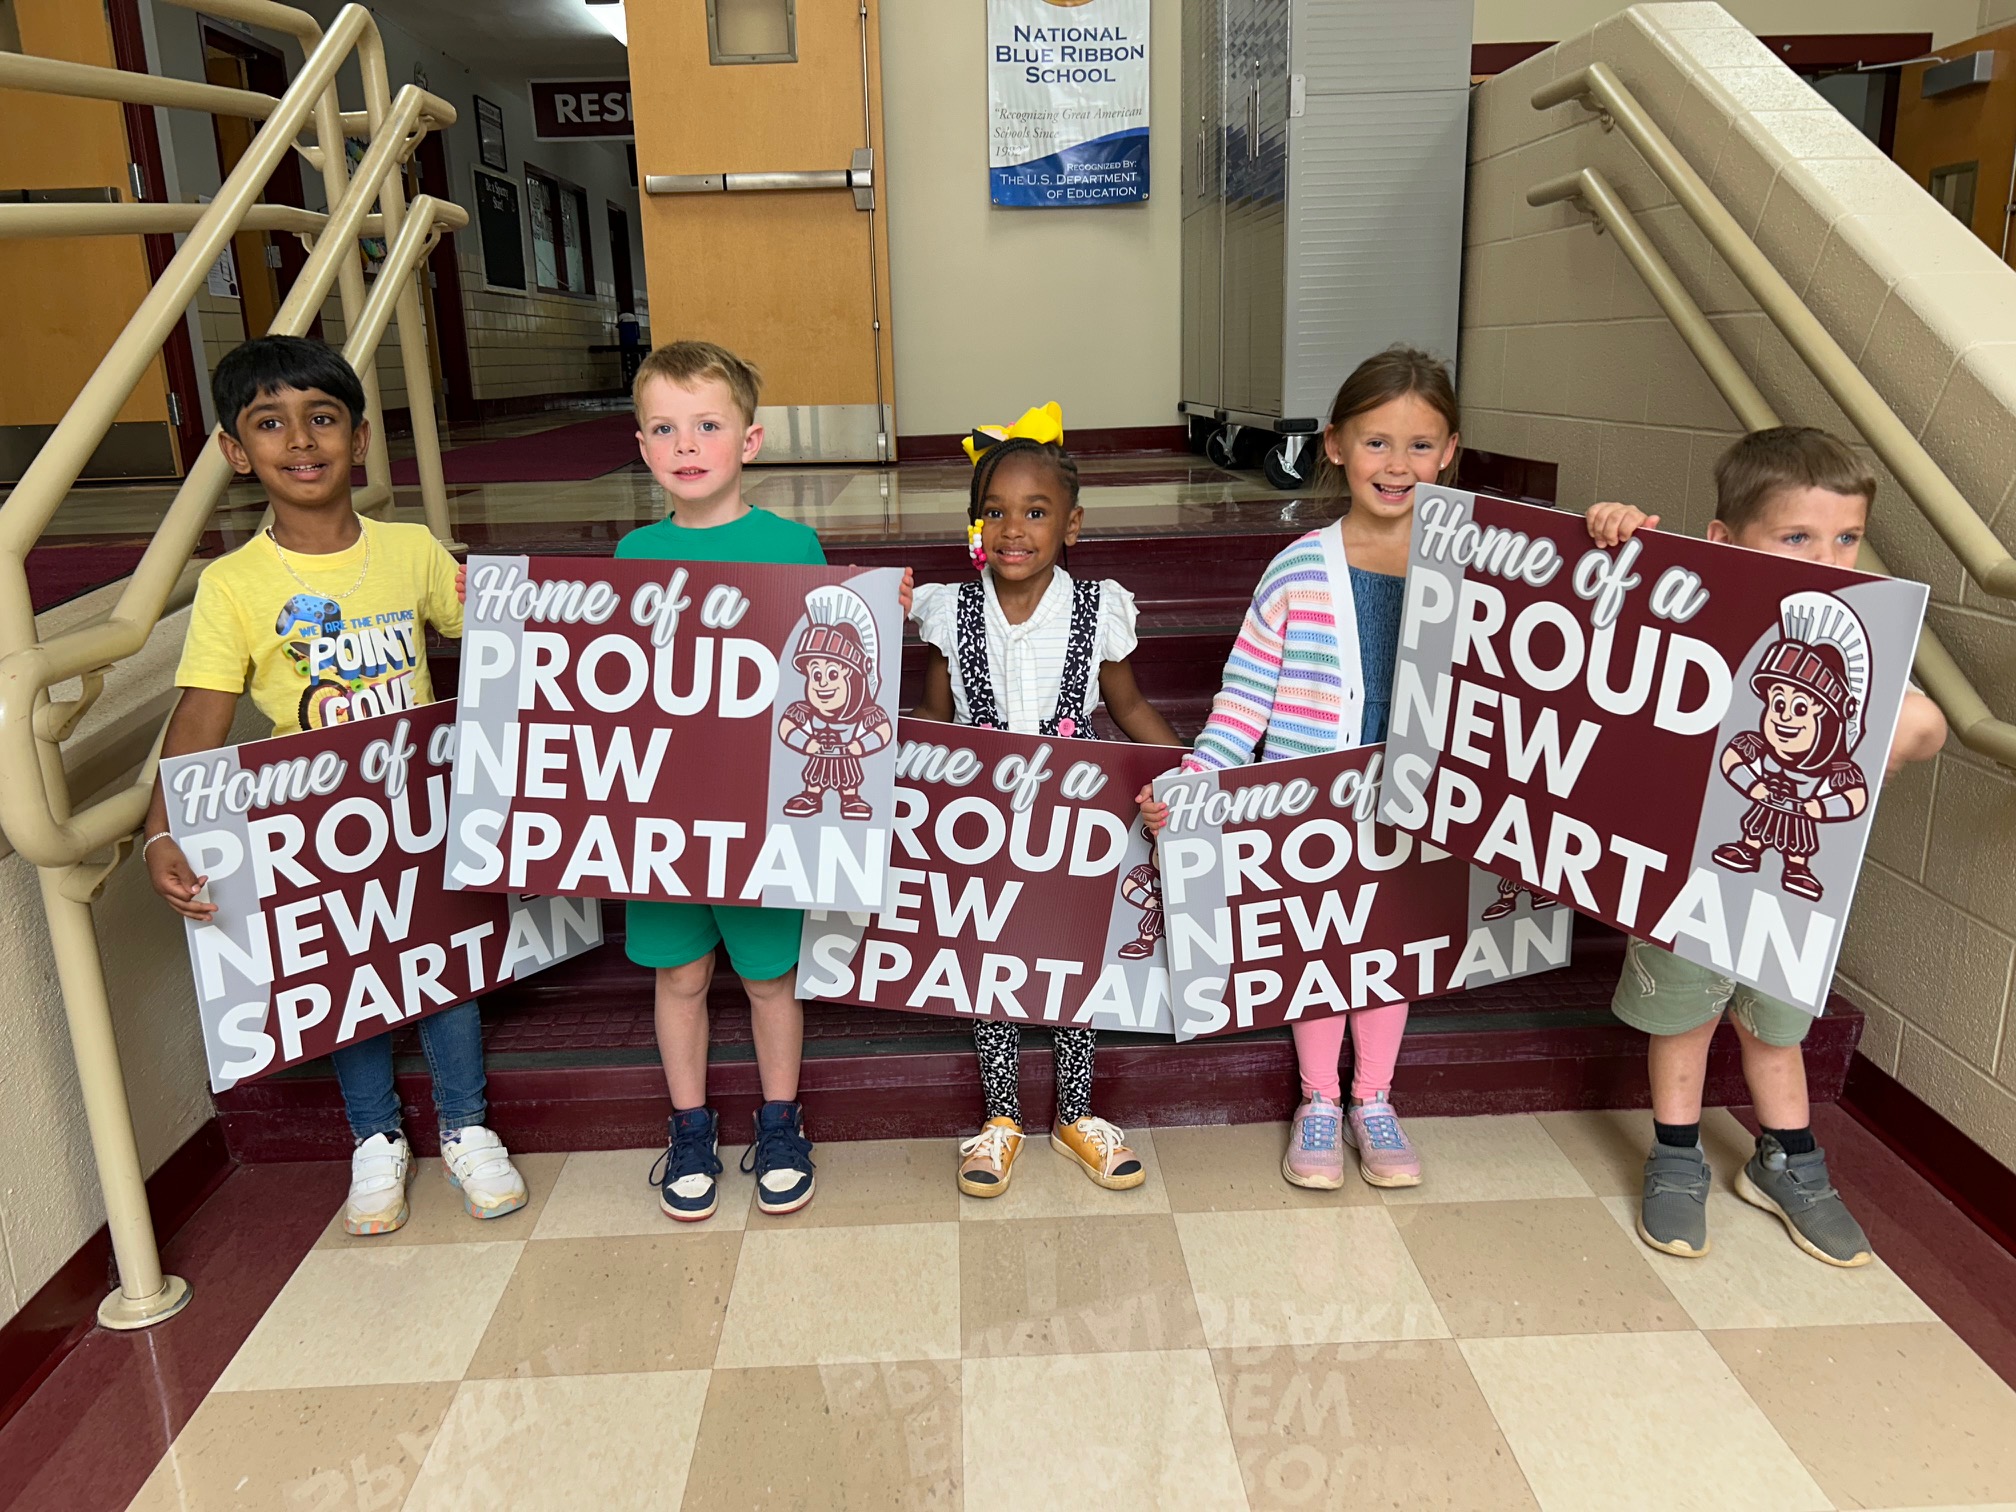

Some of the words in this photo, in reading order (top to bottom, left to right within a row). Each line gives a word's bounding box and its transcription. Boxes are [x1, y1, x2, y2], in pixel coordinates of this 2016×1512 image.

[996, 45, 1054, 63] BLUE
[1061, 45, 1144, 62] RIBBON
[1014, 25, 1127, 42] NATIONAL
[1026, 66, 1116, 83] SCHOOL
[554, 92, 633, 123] RES
[994, 126, 1030, 138] Schools
[1033, 127, 1059, 138] Since
[1062, 108, 1090, 121] Great
[1094, 107, 1142, 121] American
[1000, 173, 1024, 185] THE
[1027, 173, 1053, 186] U.S.
[1057, 172, 1137, 184] DEPARTMENT
[1066, 162, 1120, 171] RECOGNIZED
[1067, 186, 1137, 199] EDUCATION
[1417, 494, 1563, 587] Home
[1573, 535, 1643, 630] of
[1649, 566, 1709, 622] a
[299, 626, 319, 638] WE
[325, 619, 346, 633] ARE
[350, 616, 373, 629] THE
[376, 610, 414, 625] FUTURE
[472, 564, 620, 624] Home
[631, 566, 691, 649] of
[700, 581, 750, 630] a
[310, 621, 416, 682] POINT
[462, 630, 780, 719] PROUD
[1402, 565, 1734, 737] PROUD
[456, 720, 673, 803] NEW
[1392, 659, 1602, 799] NEW
[171, 751, 348, 826] Home
[360, 718, 416, 799] of
[428, 724, 457, 766] a
[896, 741, 982, 786] me
[992, 742, 1053, 813] of
[1060, 759, 1108, 800] a
[1161, 777, 1319, 833] Home
[1330, 750, 1386, 822] of
[180, 774, 451, 900] PROU
[450, 807, 886, 907] SPARTAN
[889, 786, 1129, 877] ROUD
[1163, 818, 1455, 905] PROU
[810, 865, 1025, 943] EW
[1383, 752, 1836, 1008] SPARTAN
[195, 867, 418, 1000] NEW
[1170, 882, 1379, 972] NEW
[218, 897, 600, 1080] SPARTAN
[1180, 910, 1569, 1035] SPARTAN
